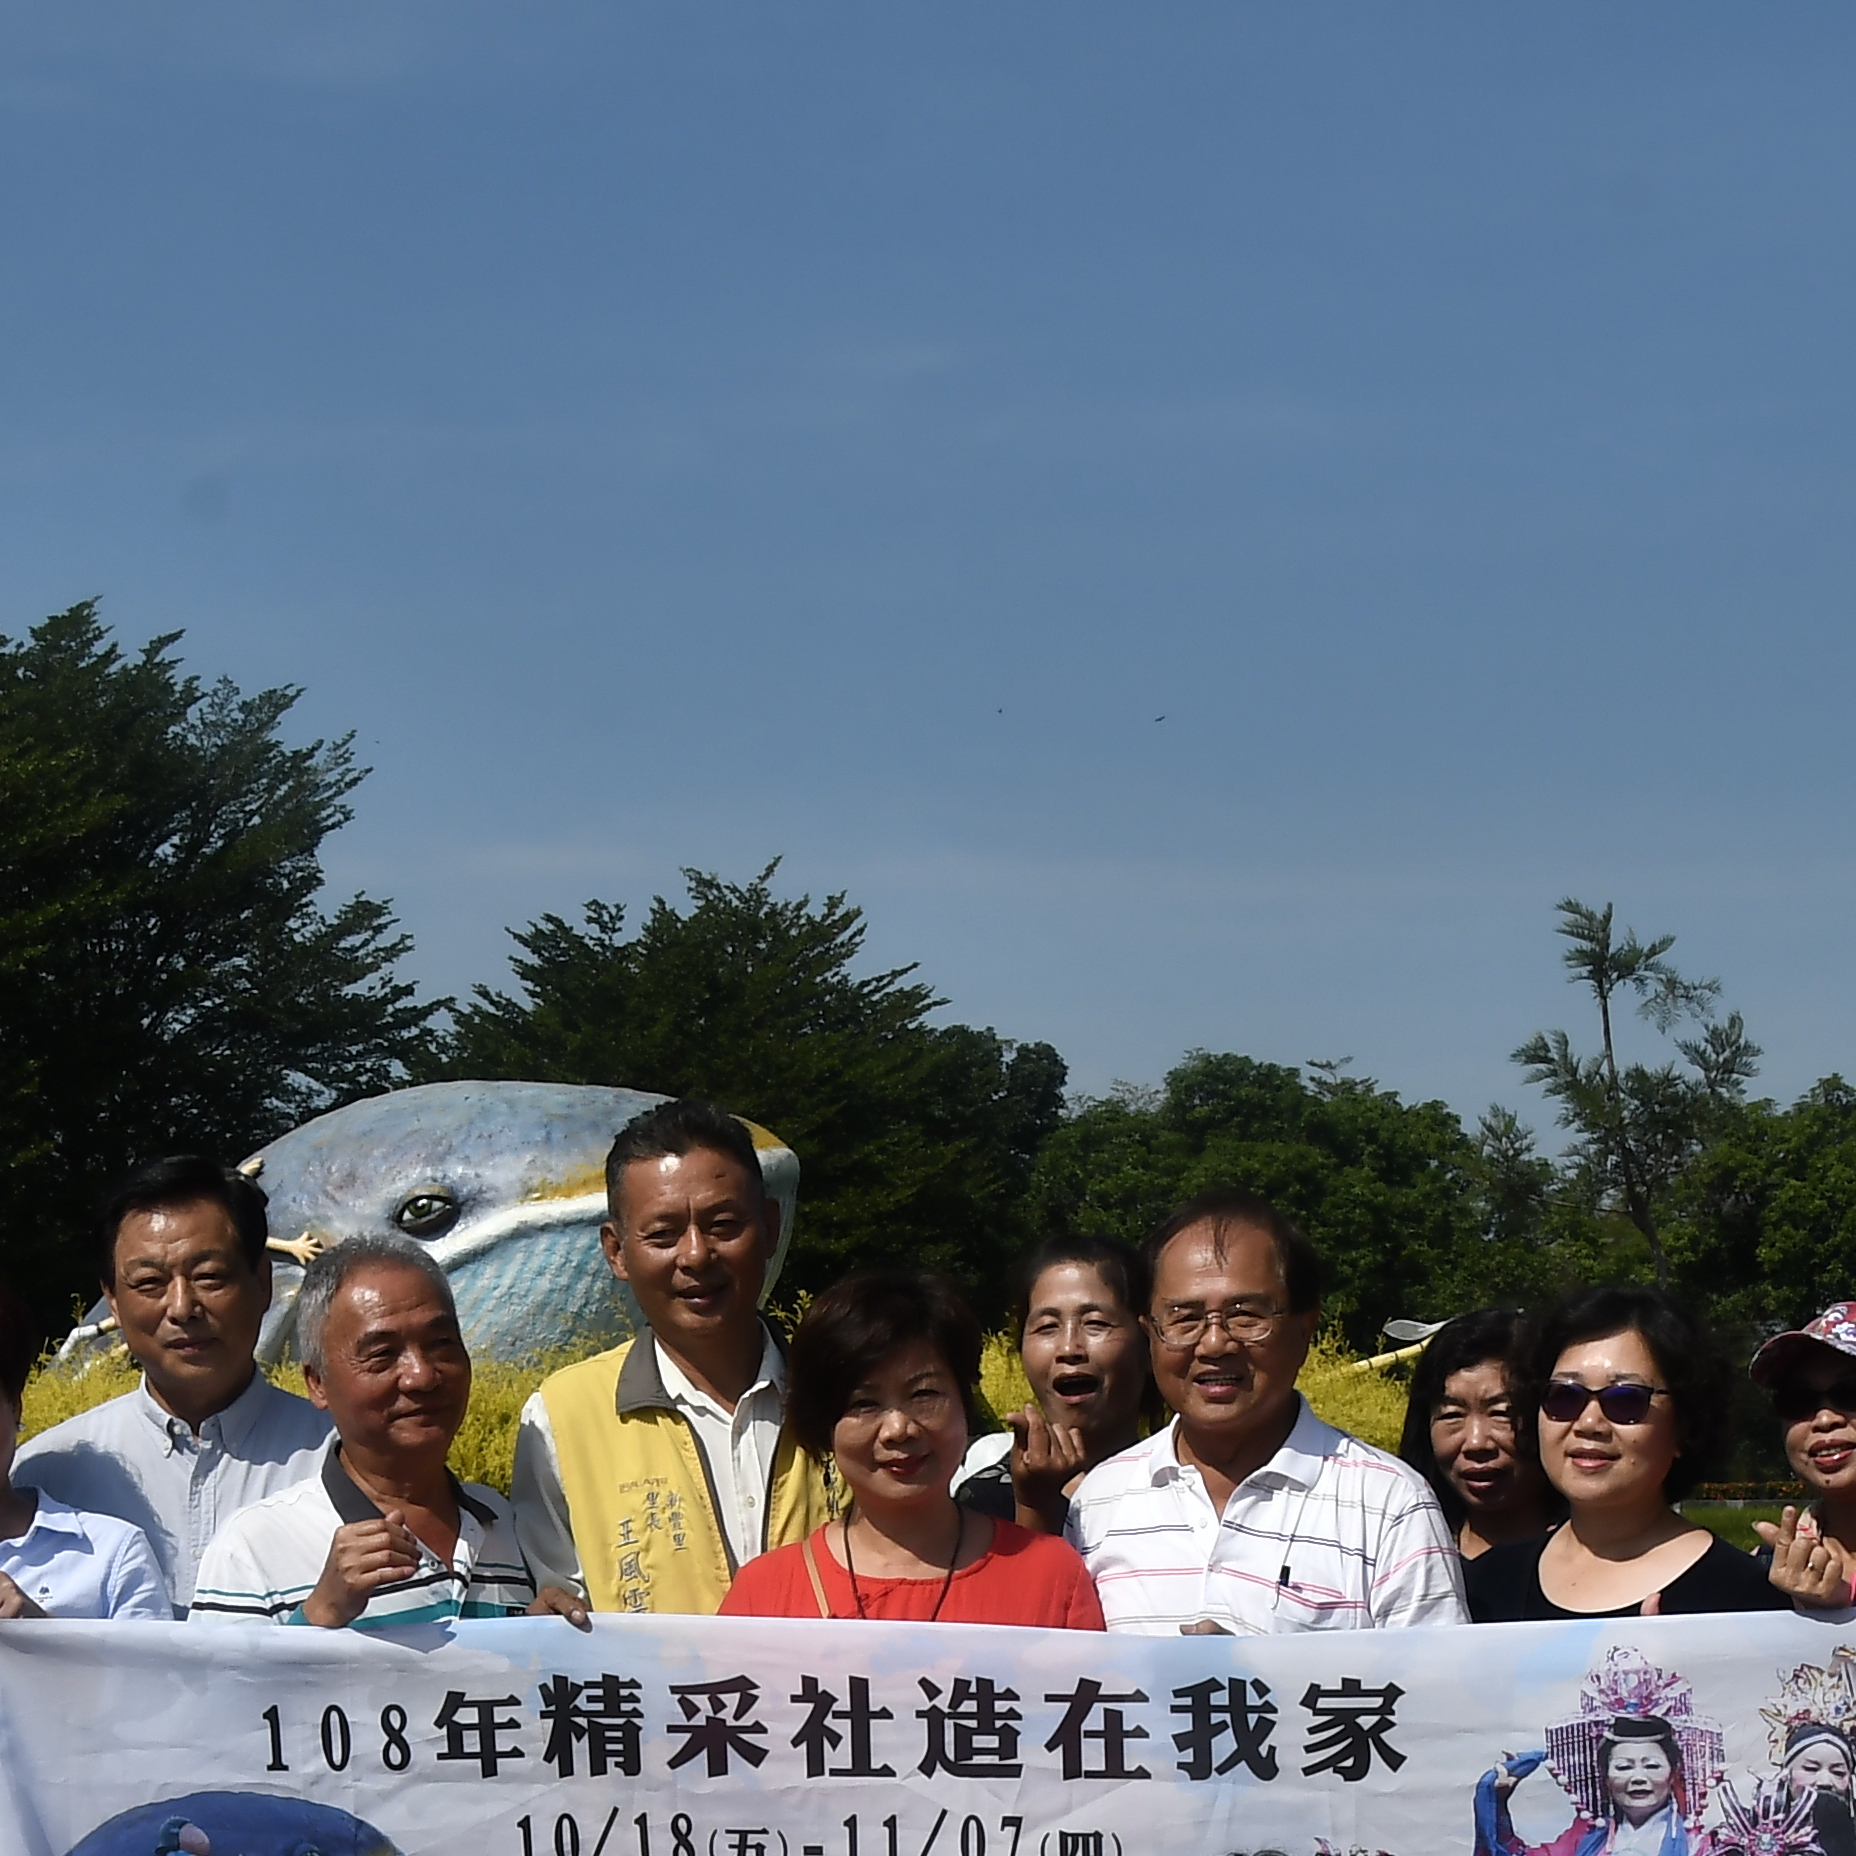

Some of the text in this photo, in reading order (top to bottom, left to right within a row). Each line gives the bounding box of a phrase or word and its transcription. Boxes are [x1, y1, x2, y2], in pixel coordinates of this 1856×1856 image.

[646, 1491, 663, 1532] 里長
[261, 1672, 1408, 1783] 108年精采社造在我家
